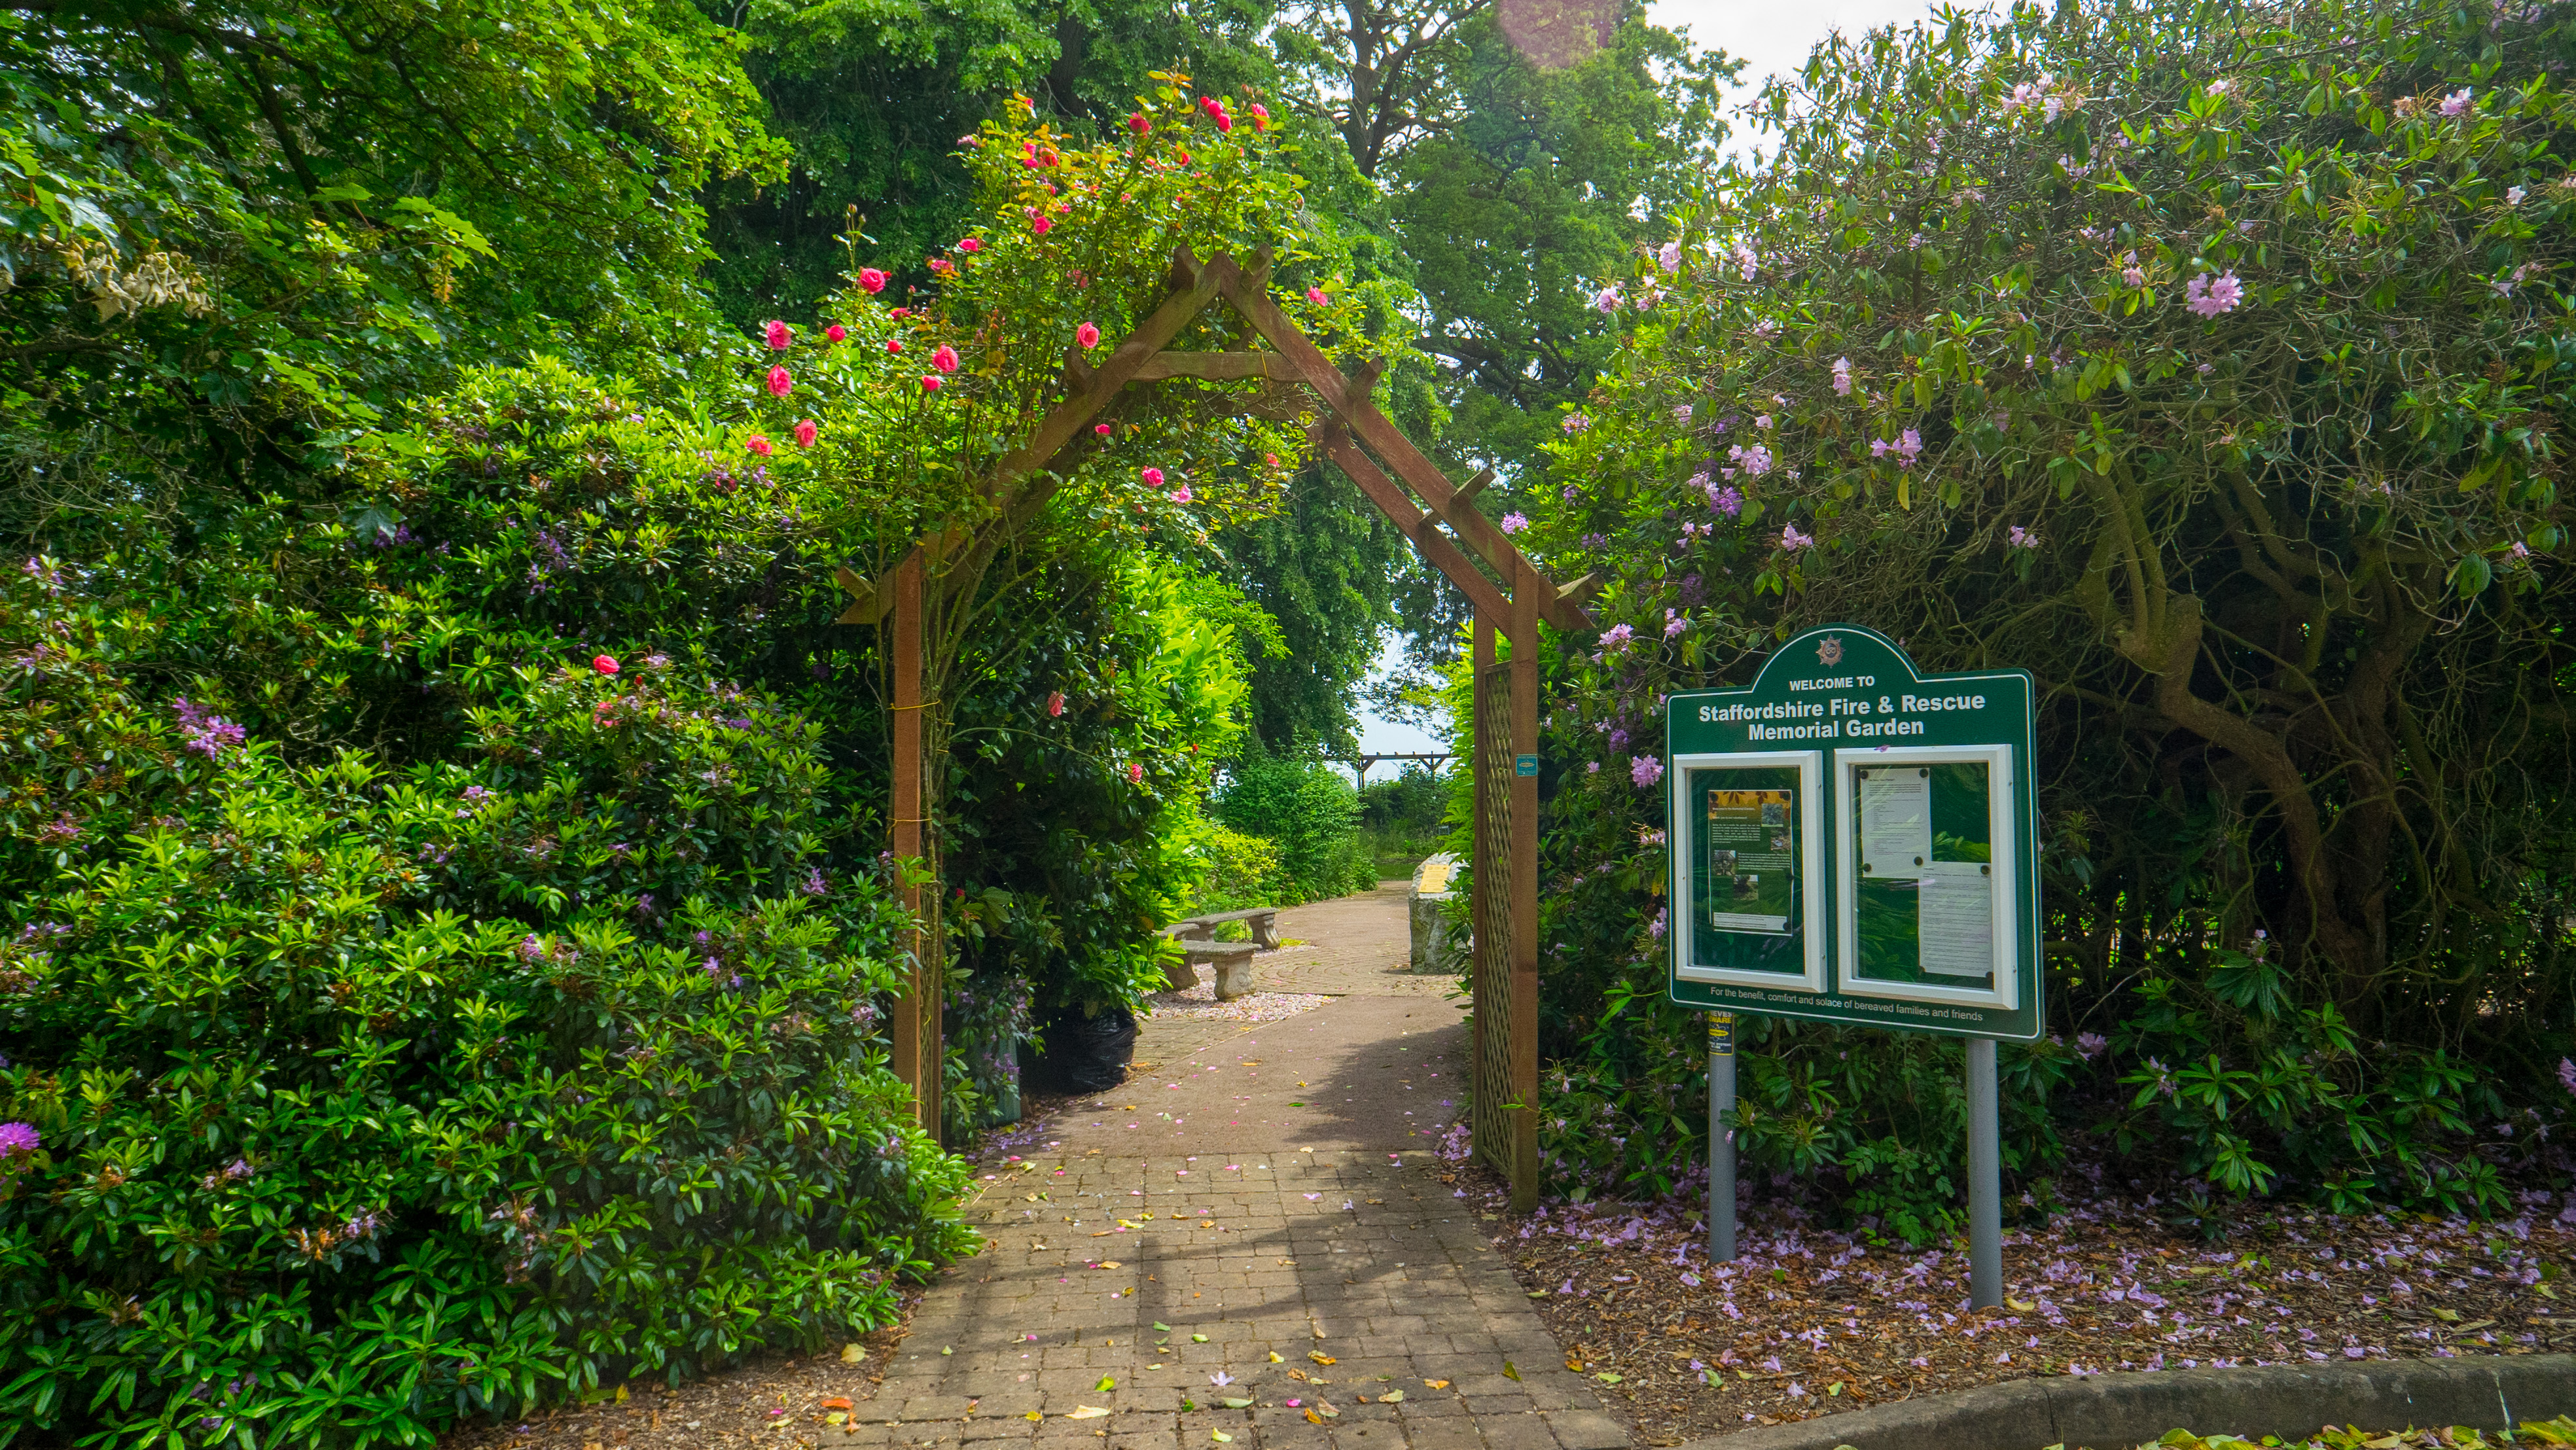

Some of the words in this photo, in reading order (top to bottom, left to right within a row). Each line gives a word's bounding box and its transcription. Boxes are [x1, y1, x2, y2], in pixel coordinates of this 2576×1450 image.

[1789, 677, 1853, 691] WELCOME
[1857, 675, 1875, 687] TO
[1699, 701, 1824, 722] Staffordshire
[1831, 698, 1870, 716] Fire
[1878, 696, 1893, 714] &
[1902, 694, 1985, 712] Rescue
[1749, 720, 1838, 741] Memorial
[1846, 718, 1923, 737] Garden
[1710, 987, 1723, 996] For
[1725, 989, 1736, 997] the
[1738, 989, 1766, 1001] benefit,
[1768, 993, 1797, 1003] comfort
[1798, 997, 1814, 1005] and
[1816, 997, 1842, 1008] solace
[1844, 1000, 1853, 1008] of
[1854, 1000, 1893, 1013] bereaved
[1896, 1004, 1930, 1016] families
[1932, 1009, 1949, 1018] and
[1952, 1009, 1983, 1021] friends
